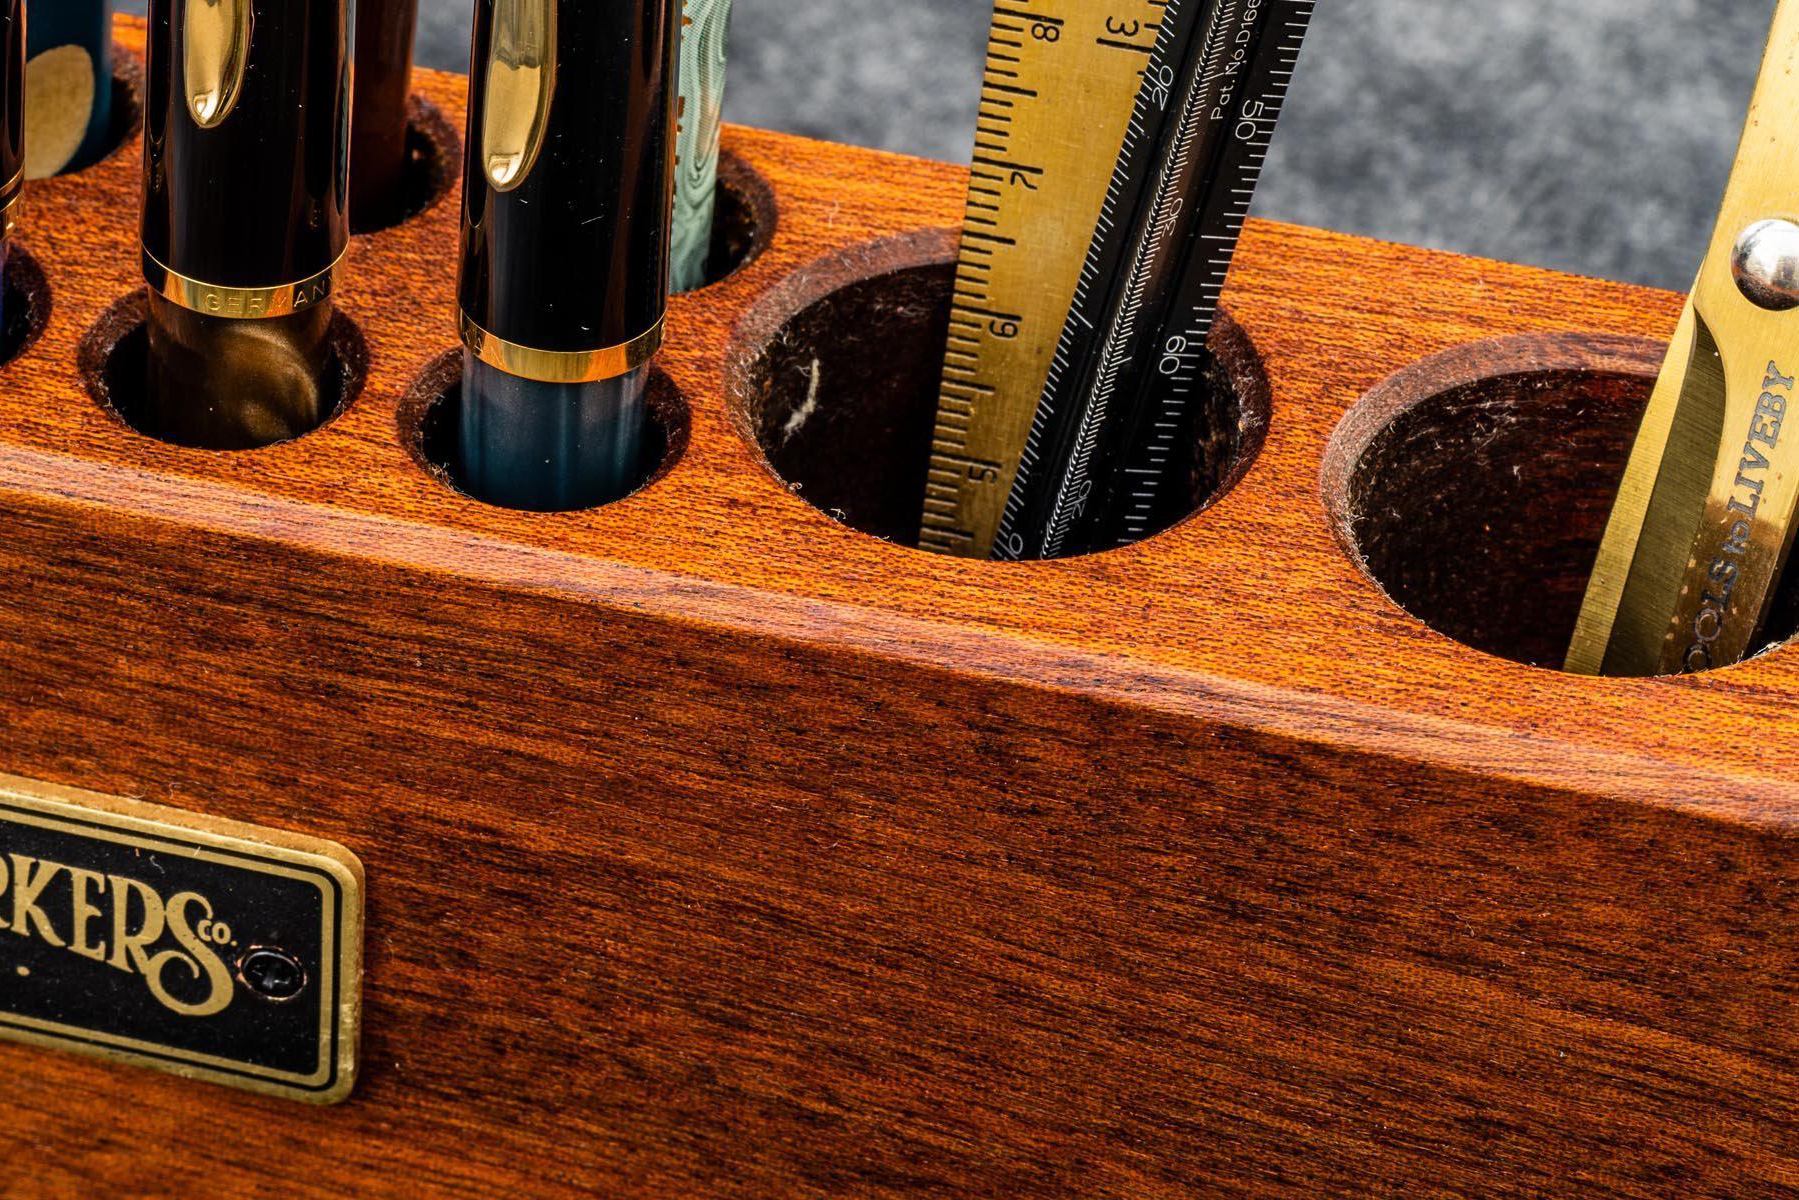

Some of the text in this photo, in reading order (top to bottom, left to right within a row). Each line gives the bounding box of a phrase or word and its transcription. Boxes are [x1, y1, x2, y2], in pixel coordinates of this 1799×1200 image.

[1030, 22, 1061, 43] 8
[1105, 15, 1139, 37] 3
[1152, 65, 1174, 111] 20
[1235, 99, 1264, 140] 50
[1010, 171, 1038, 190] 7
[989, 321, 1018, 339] 6
[1159, 335, 1187, 375] 60
[968, 466, 998, 485] 5
